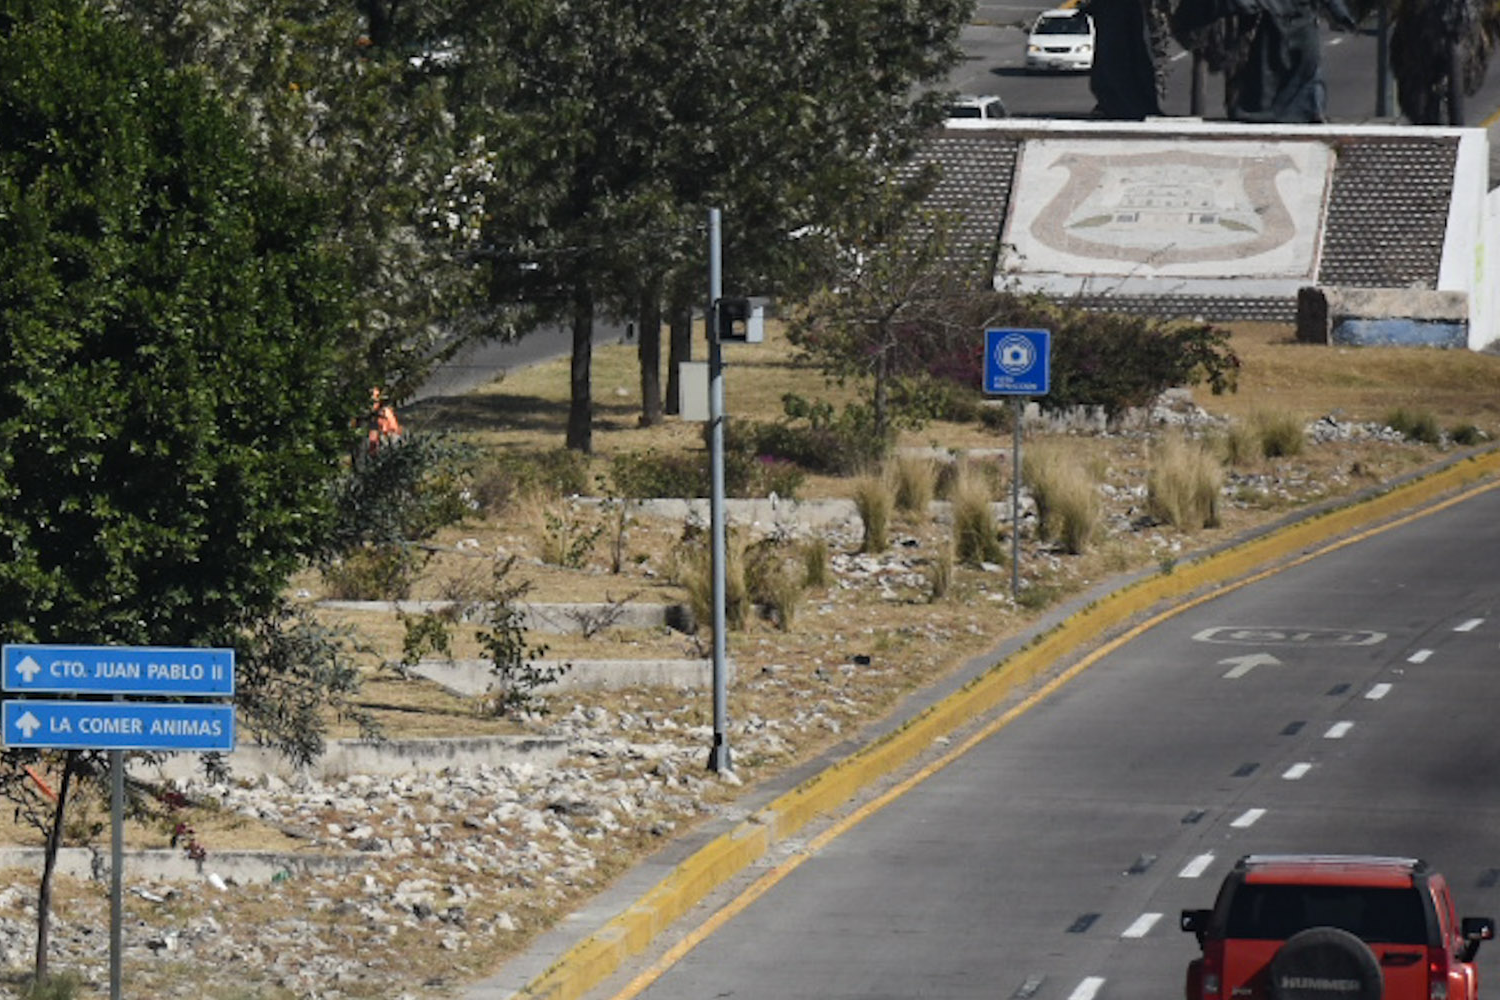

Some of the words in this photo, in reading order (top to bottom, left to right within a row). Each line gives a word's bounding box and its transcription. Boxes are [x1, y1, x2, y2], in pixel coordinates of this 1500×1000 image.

[50, 660, 87, 678] CTO.
[94, 661, 140, 679] JUAN
[147, 663, 204, 681] PABLO
[211, 664, 223, 681] II
[50, 717, 72, 734] LA
[78, 717, 143, 735] COMER
[150, 719, 222, 736] ANIMAS
[1281, 976, 1360, 991] HUMMER
